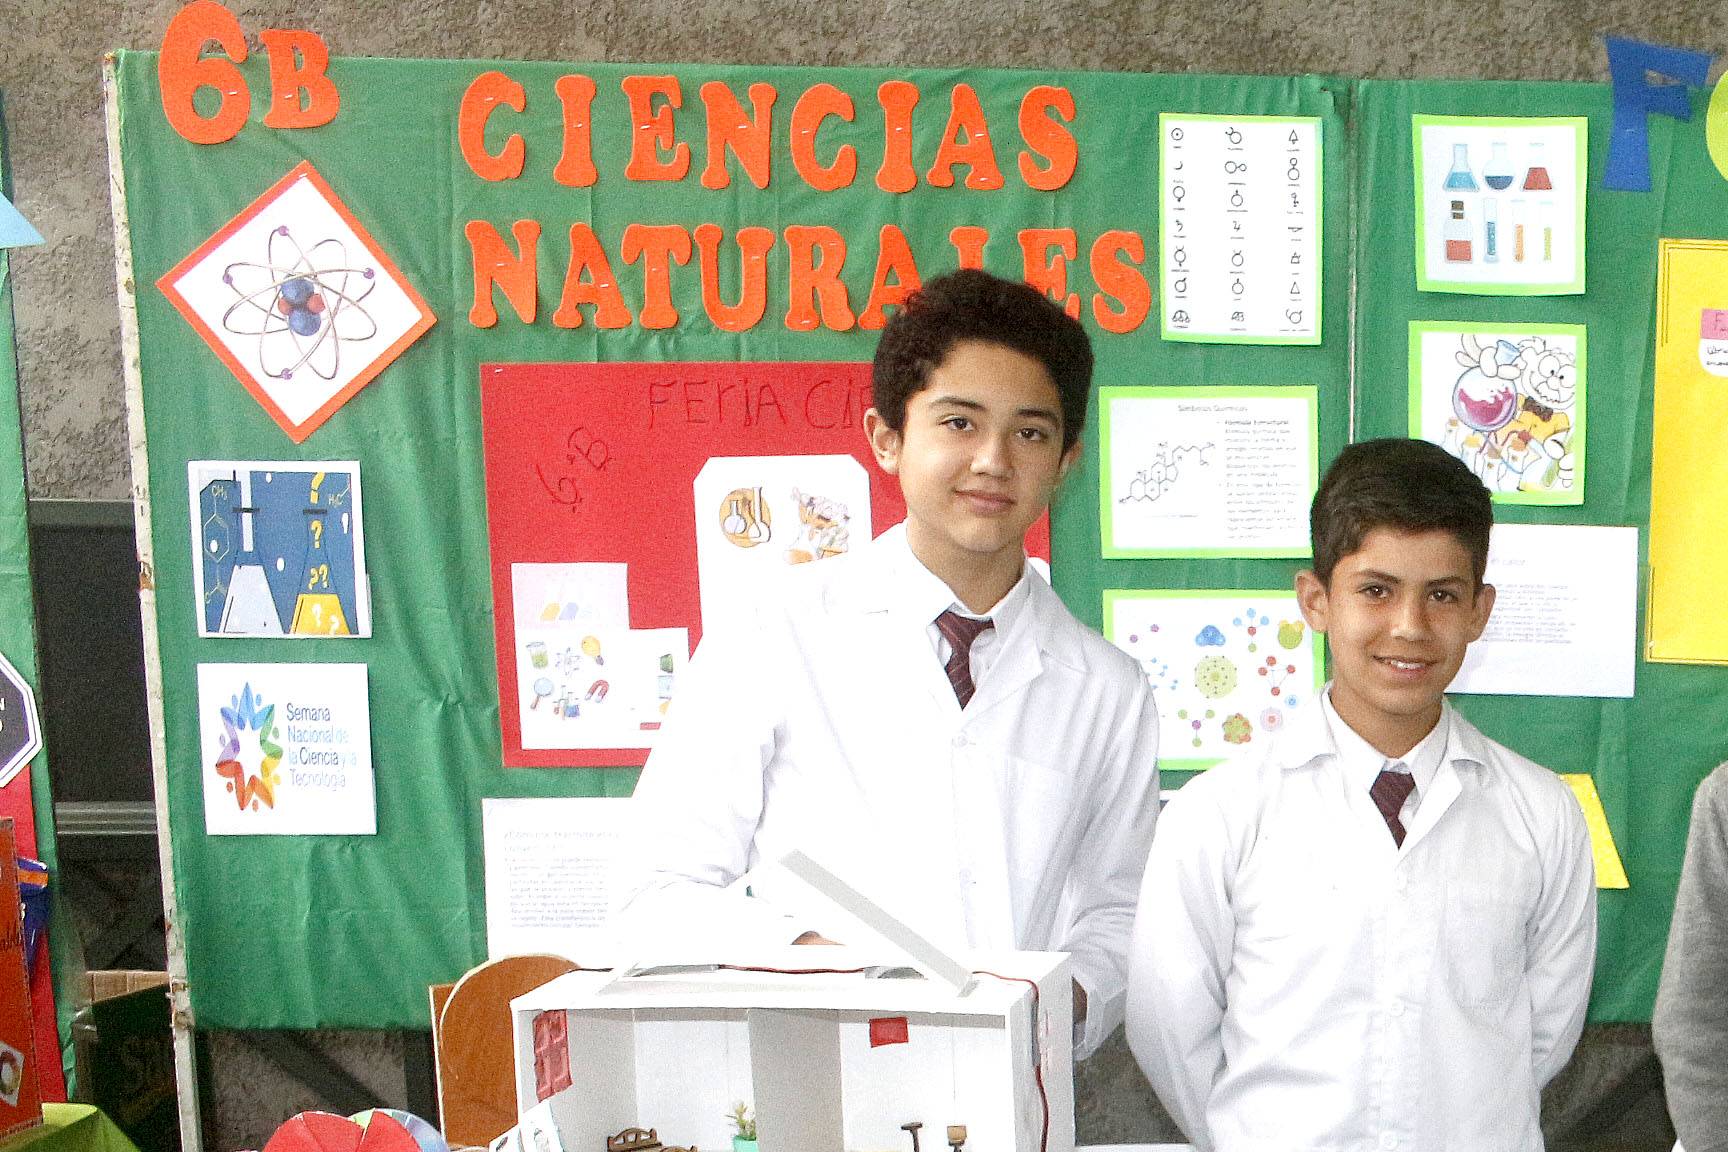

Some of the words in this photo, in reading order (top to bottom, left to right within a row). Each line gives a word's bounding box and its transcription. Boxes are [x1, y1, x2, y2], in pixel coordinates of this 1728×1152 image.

[458, 71, 1078, 193] CIENCIAS
[286, 702, 331, 722] Semana
[287, 724, 334, 744] Nacional
[299, 746, 339, 766] Ciencia
[289, 767, 346, 792] Tecnología
